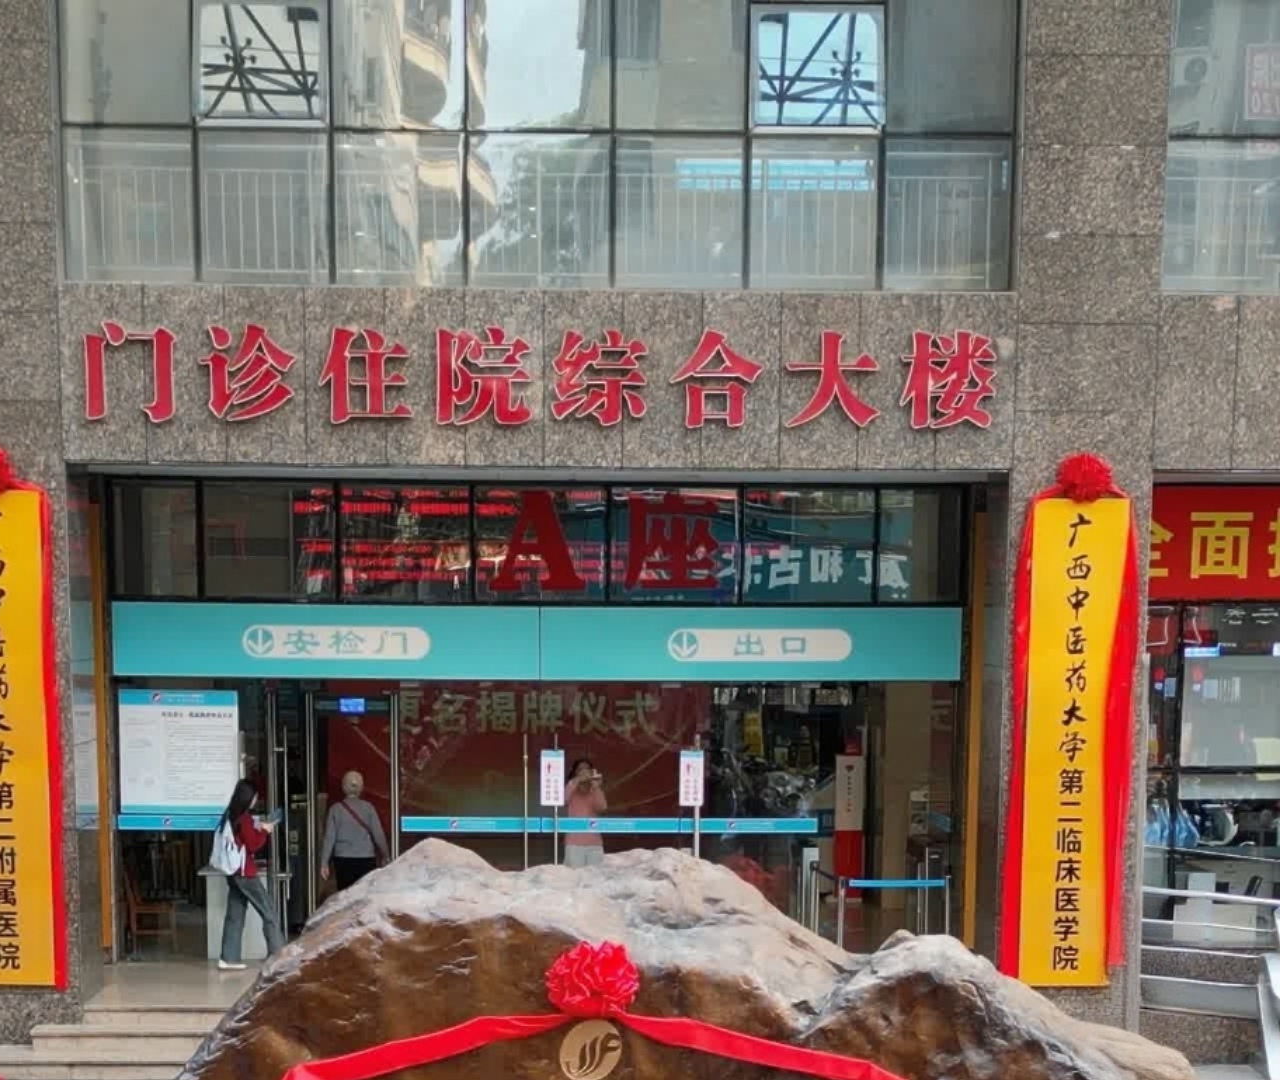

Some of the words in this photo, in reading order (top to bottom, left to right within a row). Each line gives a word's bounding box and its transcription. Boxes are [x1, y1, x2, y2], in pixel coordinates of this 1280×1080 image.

[82, 320, 1000, 431] 门诊住院综合大楼
[282, 629, 410, 656] 安检门
[732, 632, 809, 657] 出口
[1051, 512, 1092, 973] 广西中医药大学第二临床医学院
